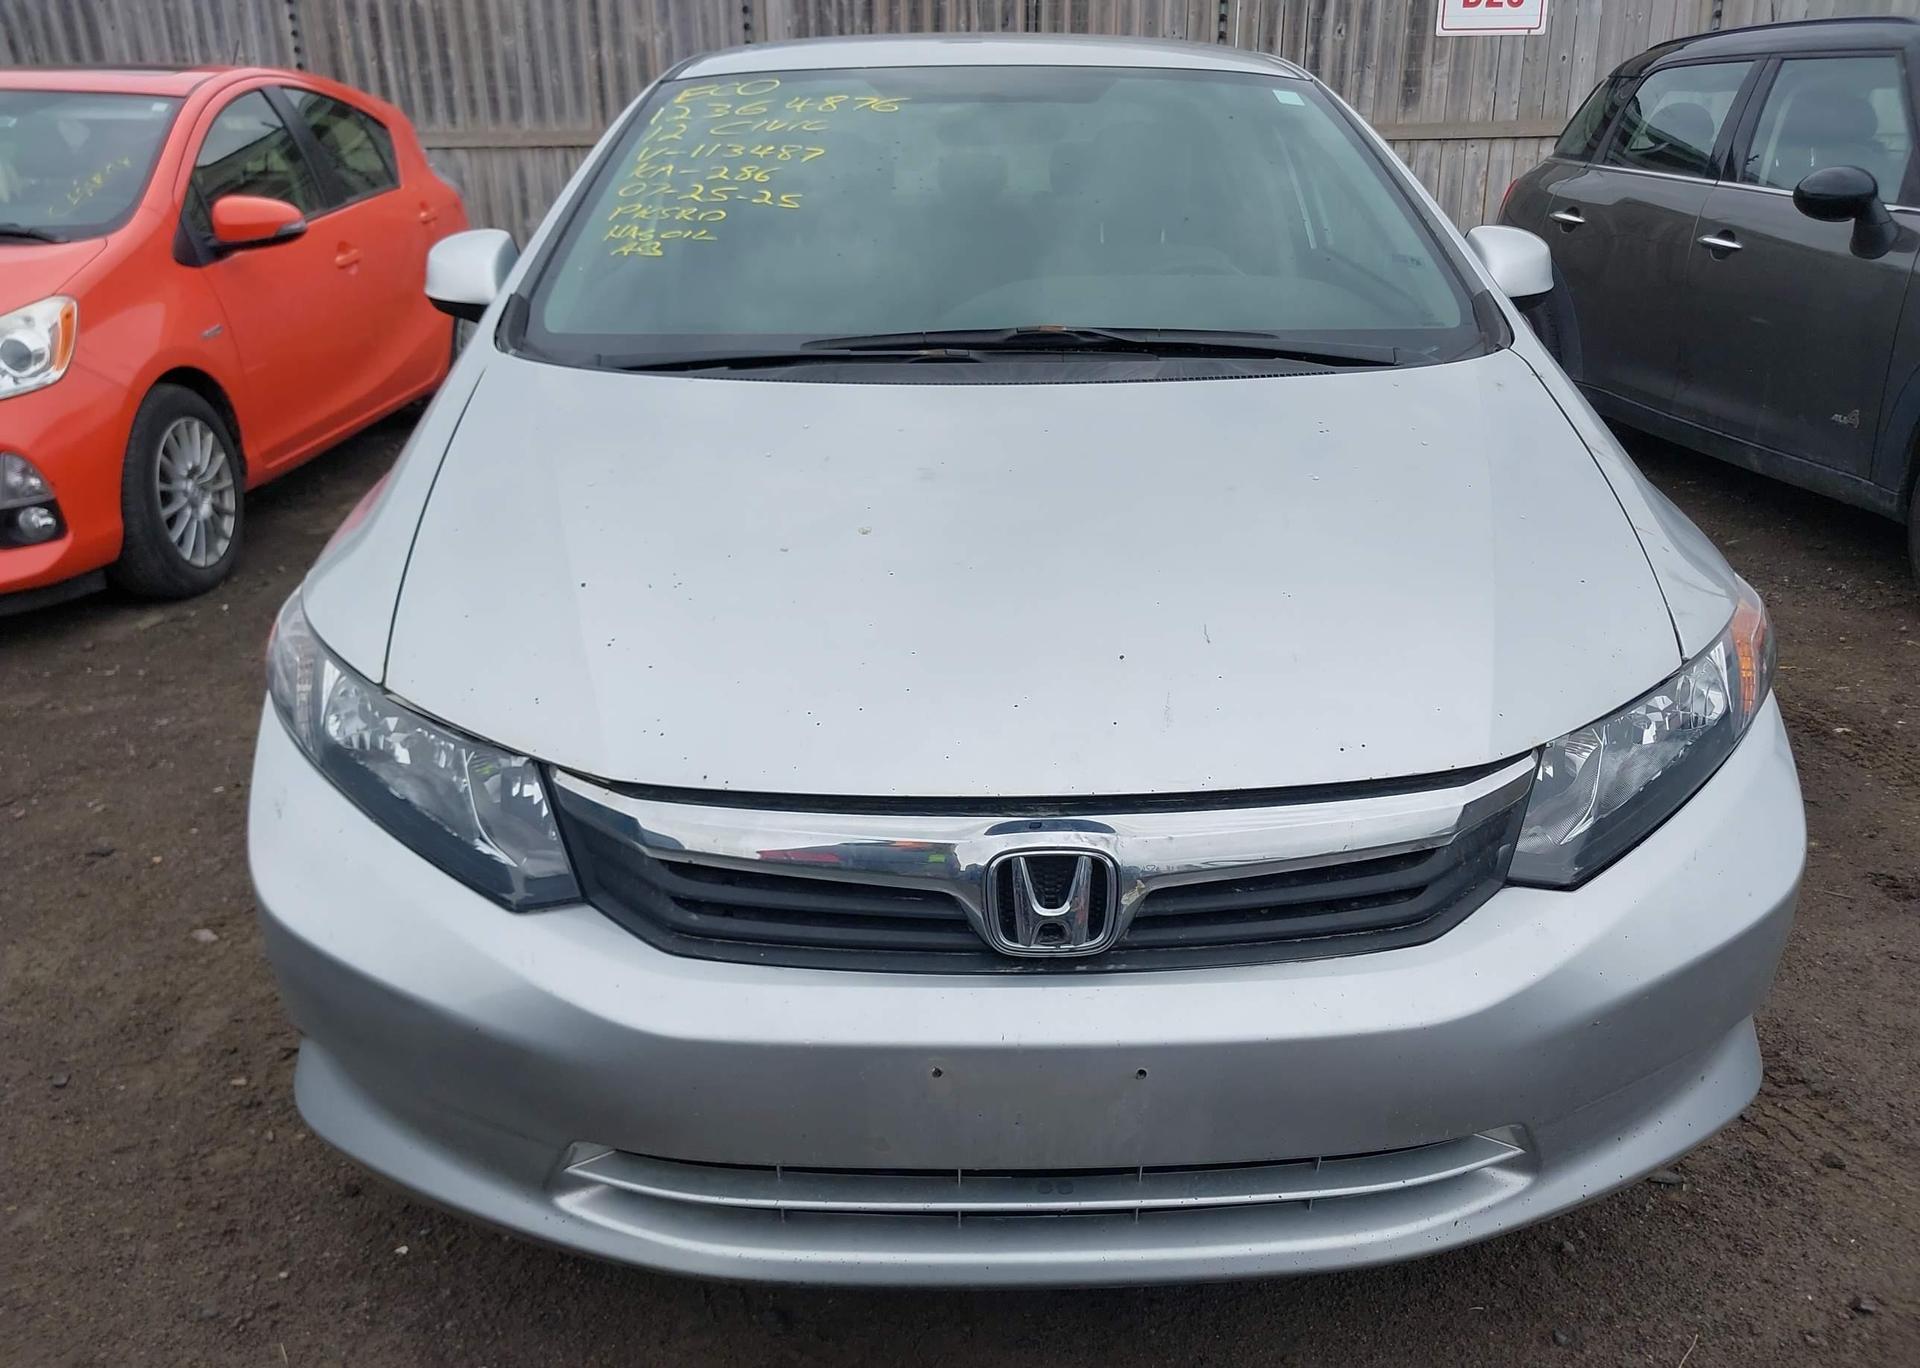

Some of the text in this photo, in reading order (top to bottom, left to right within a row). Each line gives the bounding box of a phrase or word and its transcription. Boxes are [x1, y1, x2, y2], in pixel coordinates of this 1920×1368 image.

[642, 120, 830, 143] 12 CIVIC
[618, 182, 803, 209] 07-25-25
